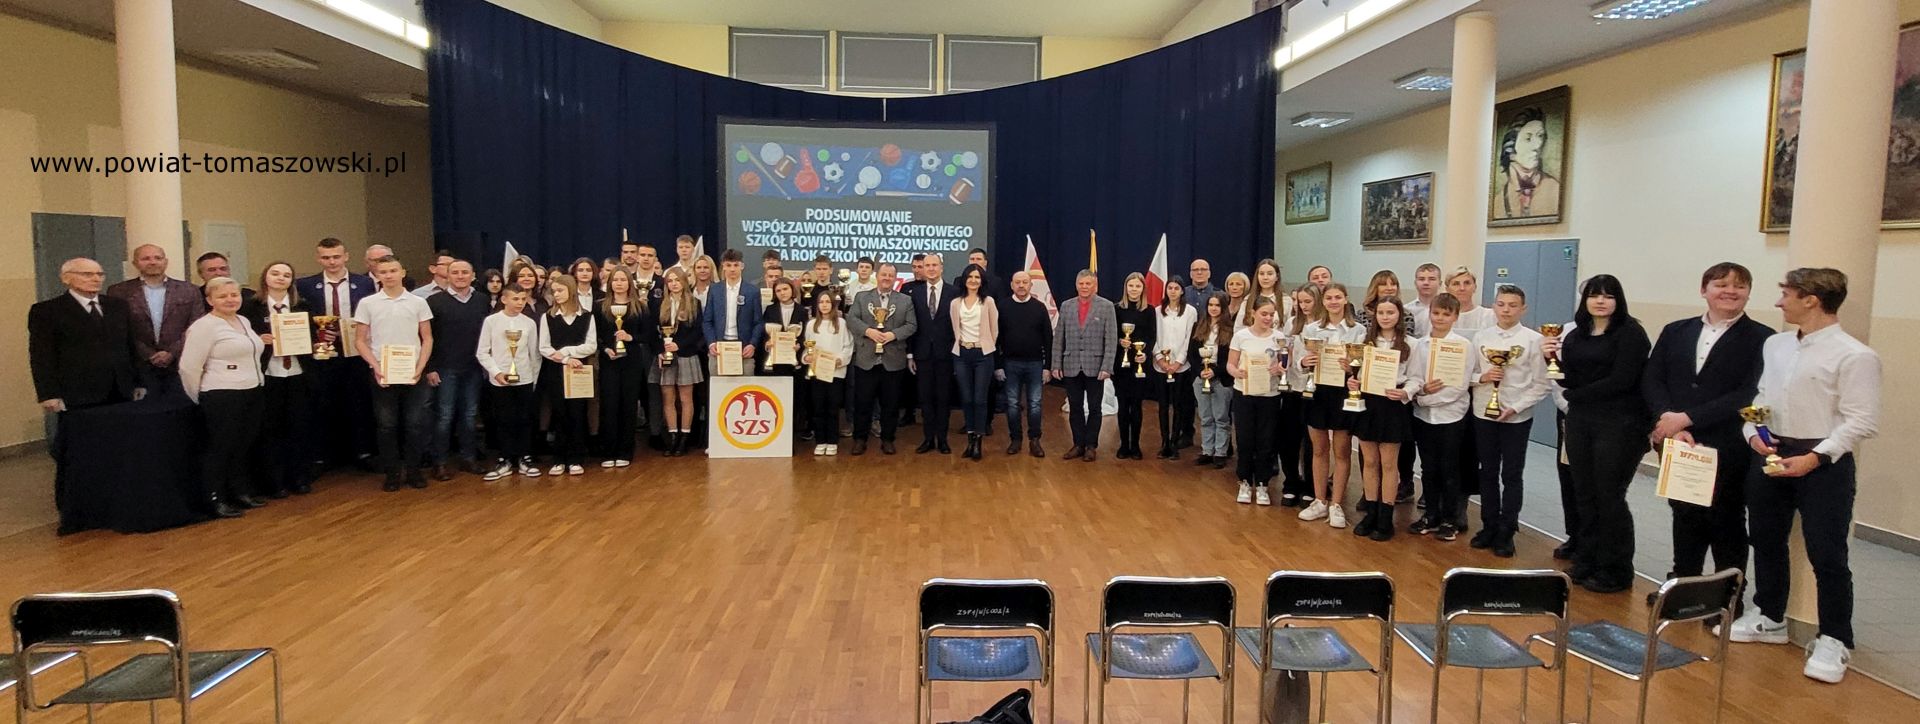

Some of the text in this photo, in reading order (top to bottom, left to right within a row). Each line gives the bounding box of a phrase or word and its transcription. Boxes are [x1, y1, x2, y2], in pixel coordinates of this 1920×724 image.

[805, 208, 912, 223] PODSUMOWANIE
[742, 219, 973, 238] WSPÓŁZAWODNICTWA SPORTOWEGO
[746, 233, 969, 251] SZKÓŁ POWIATU TOMASZOWSKIEGO
[791, 249, 816, 261] ROK
[878, 251, 944, 264] 2022/3
[732, 419, 771, 436] SZS
